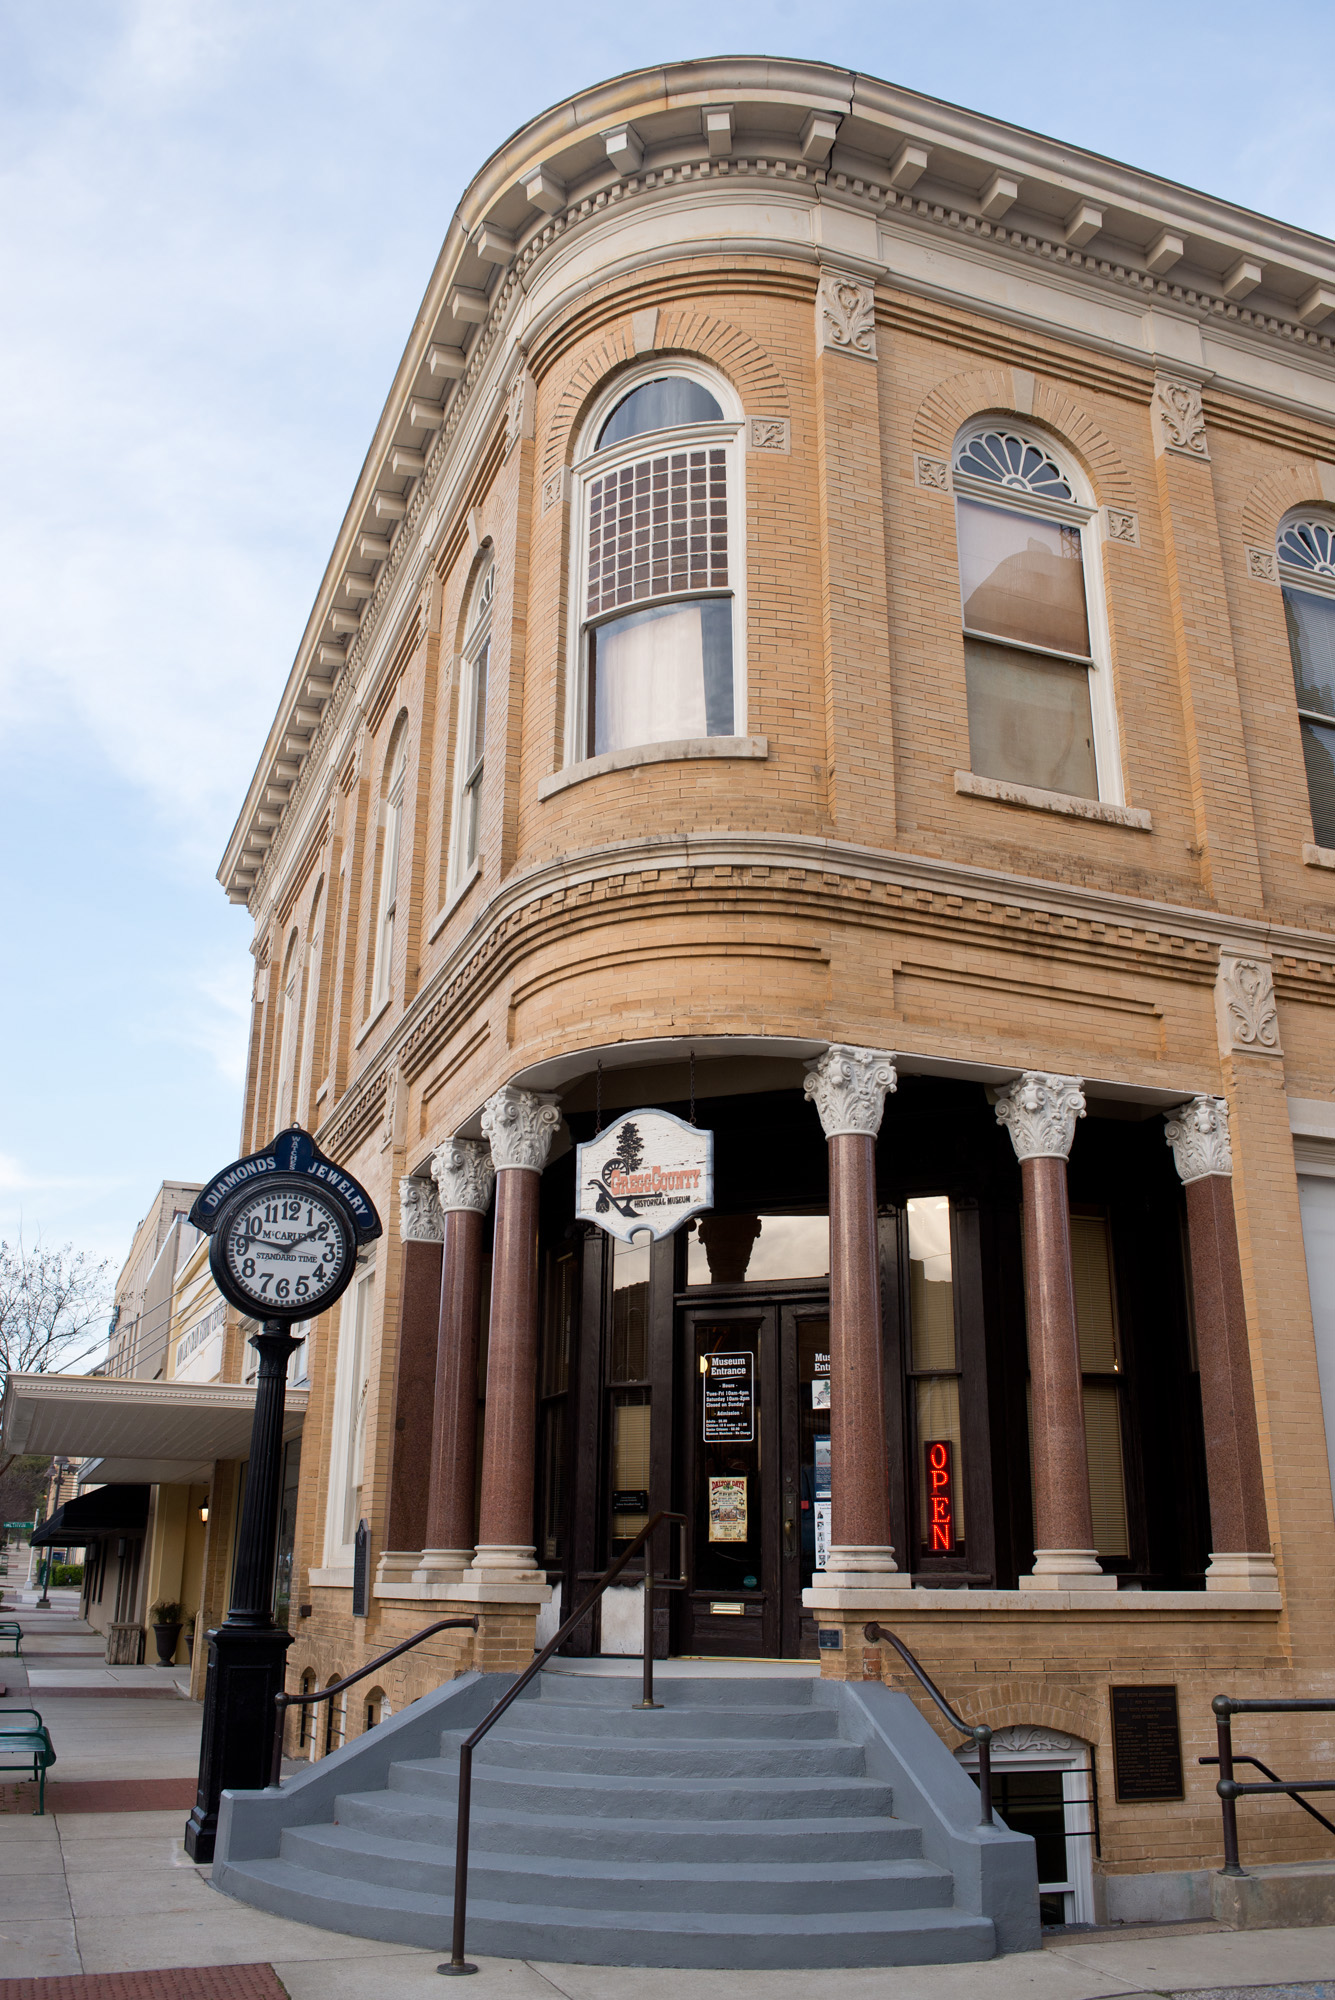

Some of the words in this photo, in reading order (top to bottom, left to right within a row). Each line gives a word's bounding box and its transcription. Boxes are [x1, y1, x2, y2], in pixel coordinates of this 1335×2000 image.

[289, 1135, 301, 1171] WATCHES
[204, 1156, 277, 1208] DIAMONDS
[307, 1161, 369, 1215] JEWELRY
[651, 1166, 701, 1192] COUNTY
[281, 1200, 302, 1221] 12
[634, 1196, 666, 1208] HISTORICAL
[667, 1195, 691, 1205] MUSEUM
[264, 1203, 279, 1224] 11
[306, 1207, 314, 1227] 1
[243, 1215, 263, 1236] 10
[317, 1221, 330, 1241] 2
[235, 1236, 250, 1257] 9
[321, 1242, 336, 1264] 3
[241, 1257, 256, 1279] 8
[256, 1252, 297, 1262] STANDARD
[298, 1255, 318, 1264] TIME
[258, 1272, 275, 1294] 7
[312, 1262, 327, 1283] 4
[275, 1278, 290, 1299] 6
[294, 1275, 310, 1297] 5
[711, 1357, 746, 1367] Museum
[815, 1353, 830, 1361] Mus
[711, 1367, 746, 1376] Entrance
[731, 1480, 745, 1491] DAYS
[930, 1443, 950, 1550] OPEN
